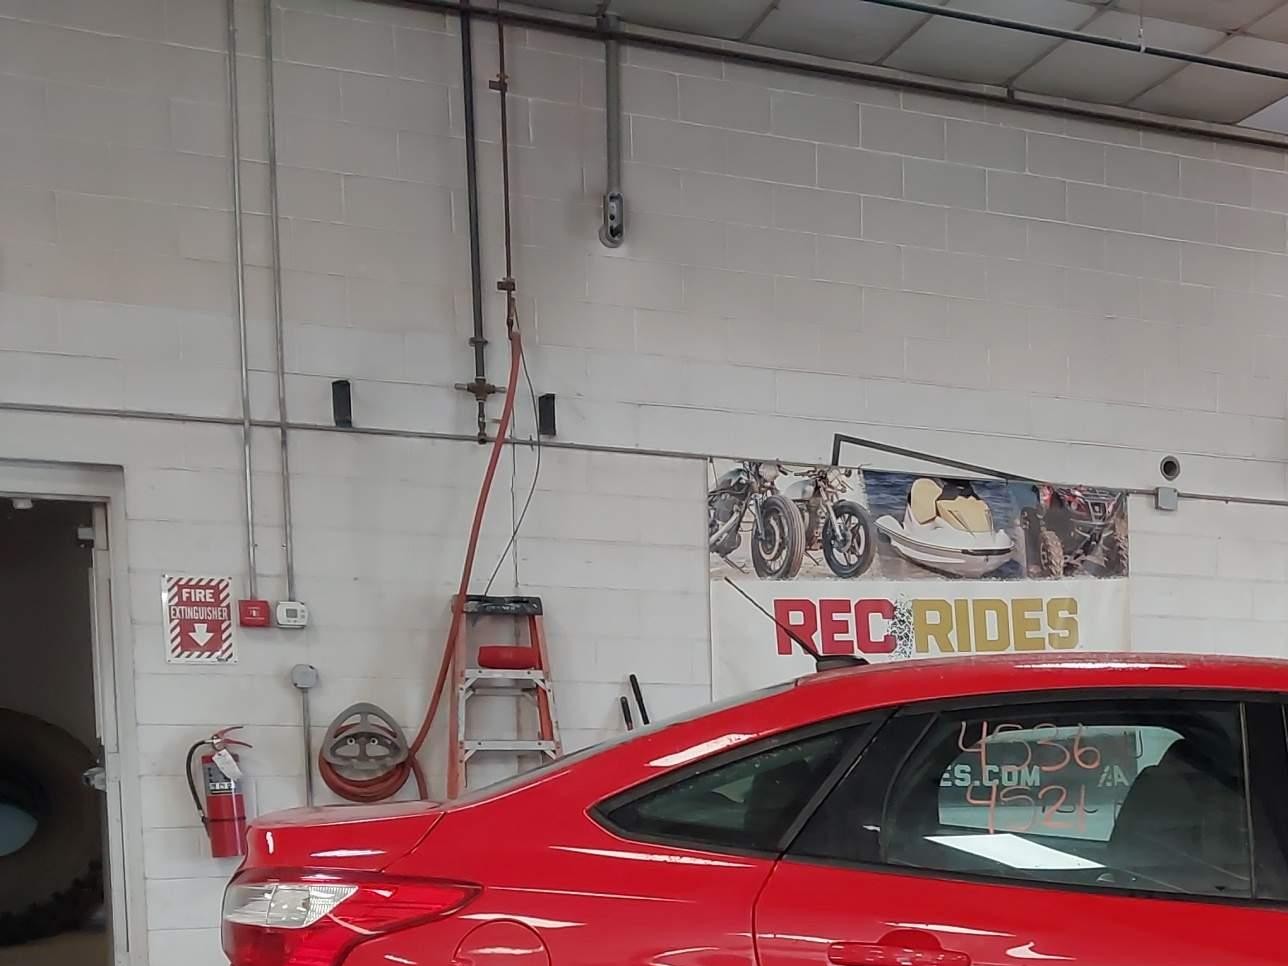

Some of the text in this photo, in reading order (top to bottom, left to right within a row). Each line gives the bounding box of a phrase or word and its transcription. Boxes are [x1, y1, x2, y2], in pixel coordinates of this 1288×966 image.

[181, 588, 215, 602] FIRE
[170, 606, 228, 620] EXTINGUISHER
[773, 597, 1080, 655] REC RIDES
